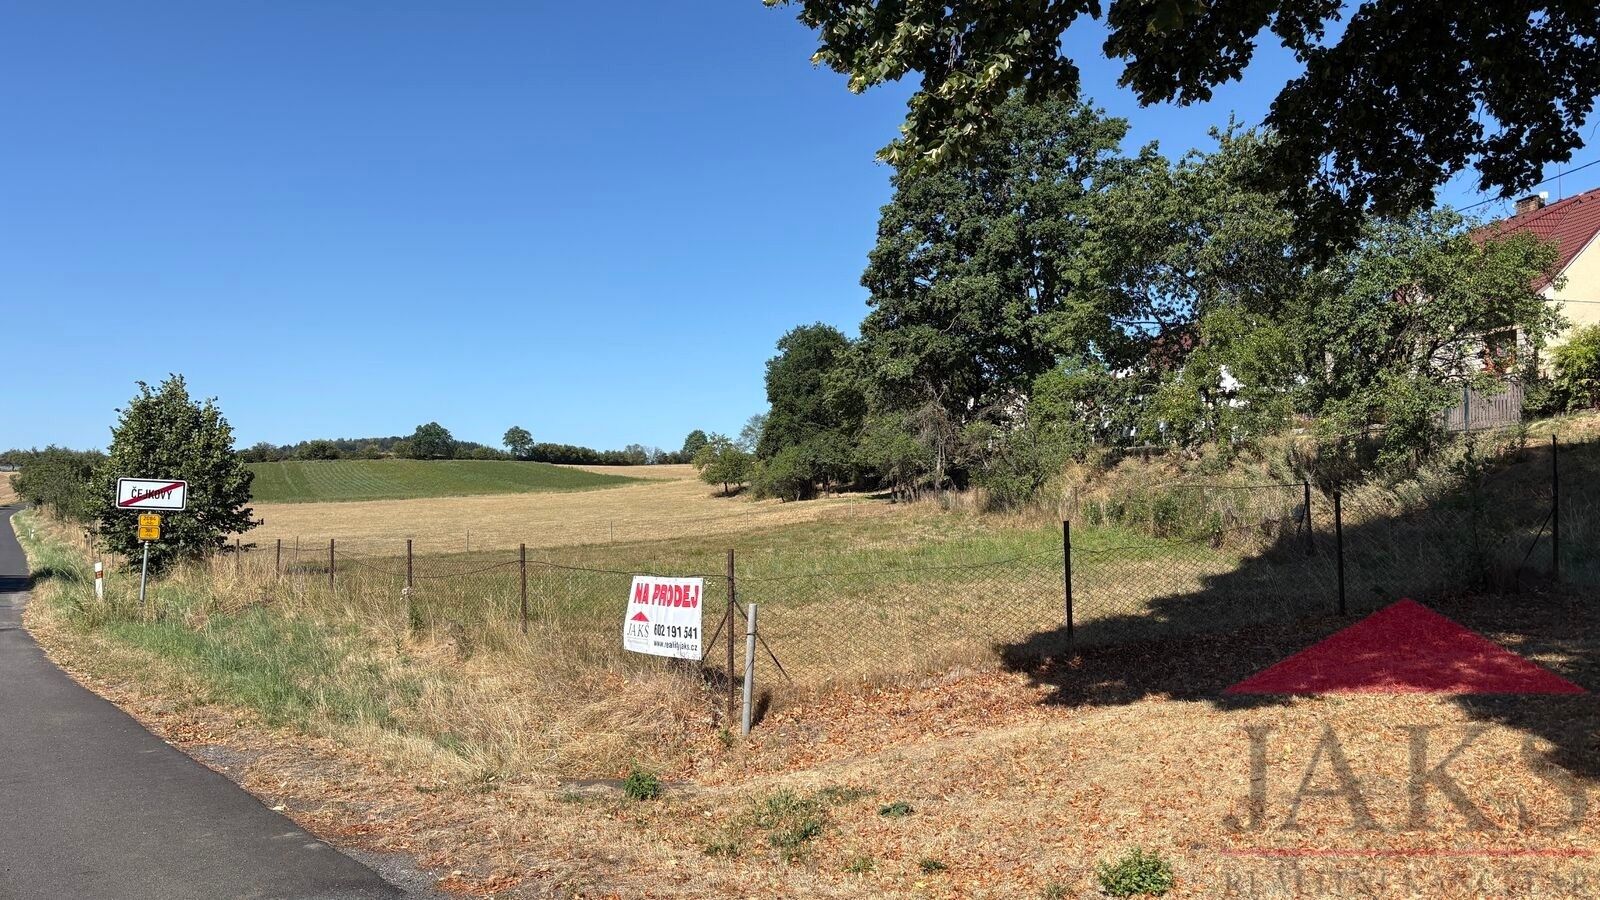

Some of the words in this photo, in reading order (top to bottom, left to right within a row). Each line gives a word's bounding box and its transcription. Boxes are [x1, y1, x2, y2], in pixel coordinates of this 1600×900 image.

[131, 485, 173, 500] ČEJKOVY
[633, 582, 650, 605] NA
[651, 583, 700, 609] PRODEJ
[653, 623, 665, 637] 602
[667, 625, 682, 638] 191
[683, 626, 698, 640] 541
